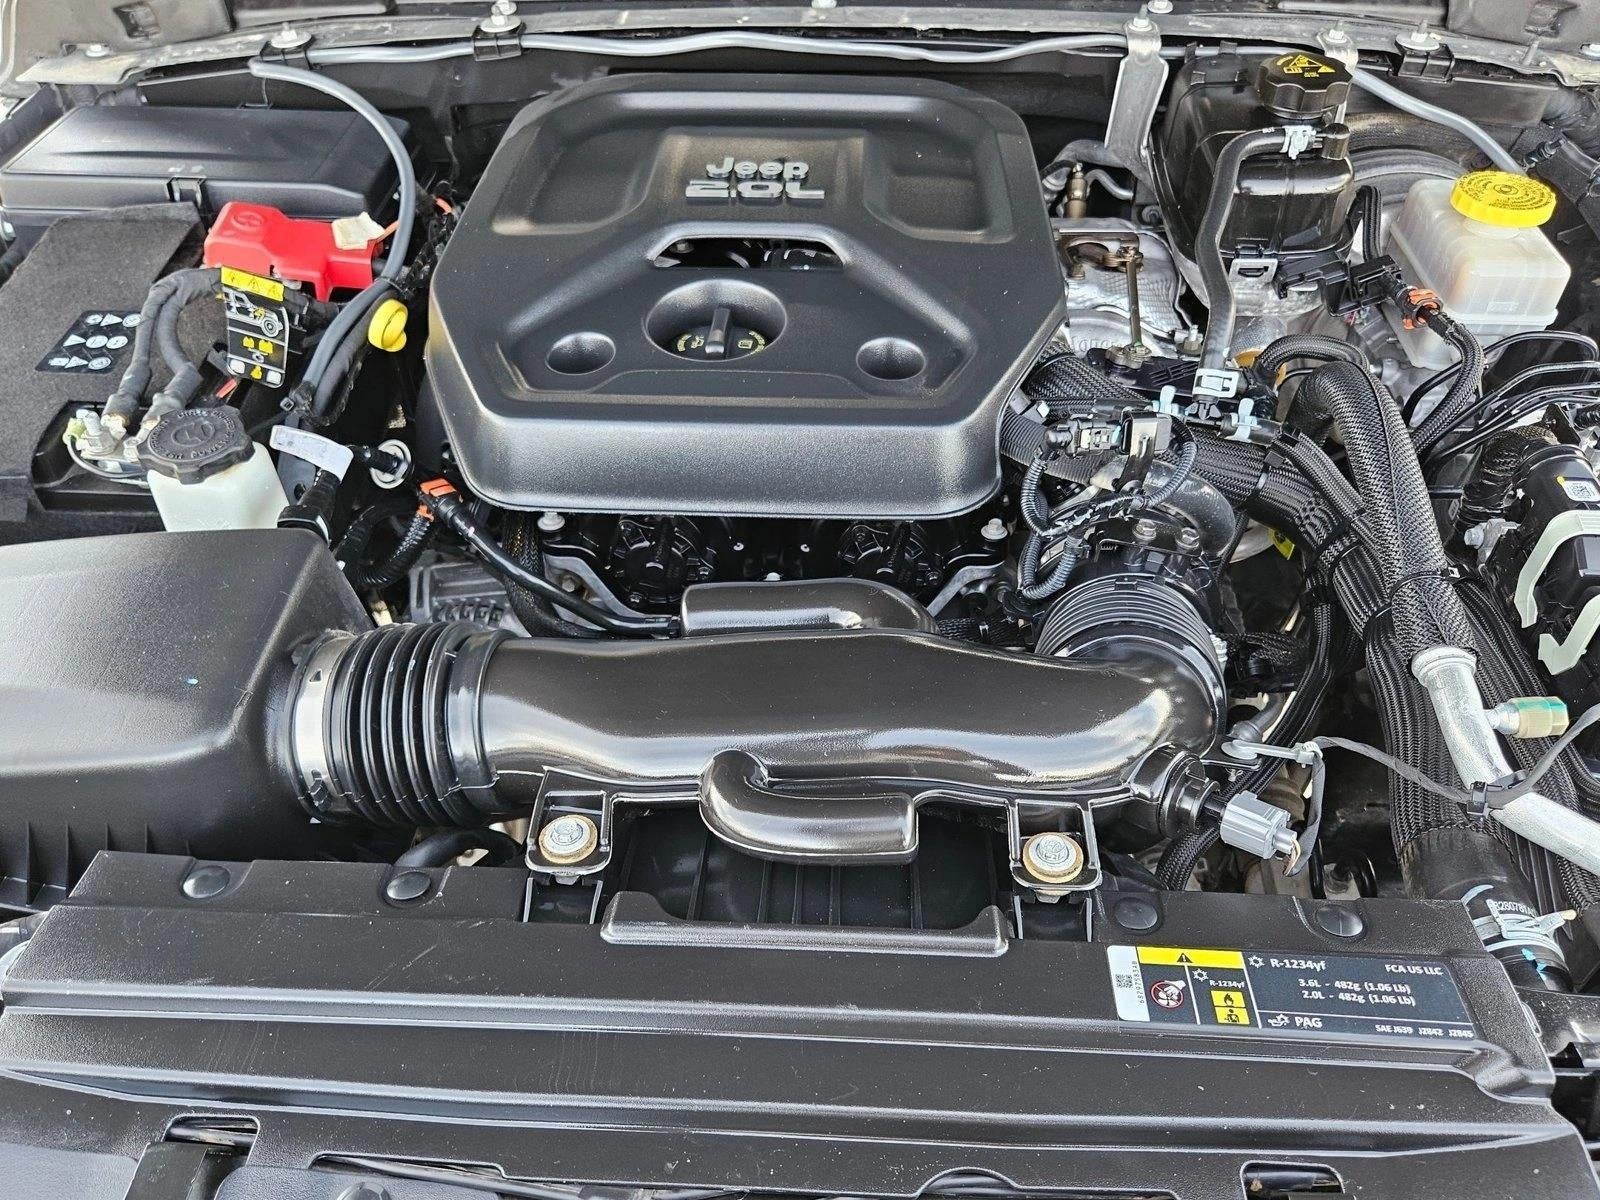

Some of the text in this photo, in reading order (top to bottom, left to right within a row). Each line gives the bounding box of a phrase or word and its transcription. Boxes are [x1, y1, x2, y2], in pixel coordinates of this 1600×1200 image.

[706, 157, 810, 180] Jeep
[685, 180, 826, 200] 2.0L
[1270, 958, 1327, 972] R-1234yf
[1384, 964, 1444, 976] FCA US LLC
[1209, 979, 1246, 989] R-1234yf
[1298, 978, 1322, 988] 3.6L
[1334, 980, 1361, 992] 482g
[1364, 981, 1392, 992] (1.06
[1392, 983, 1411, 995] Lb)
[1301, 990, 1326, 999] 2.0L
[1338, 992, 1366, 1004] 482g
[1368, 993, 1397, 1005] (1.06
[1397, 995, 1416, 1007] Lb)
[1294, 1016, 1323, 1029] PAG
[1374, 1024, 1393, 1033] SAE
[1393, 1025, 1414, 1035] J639
